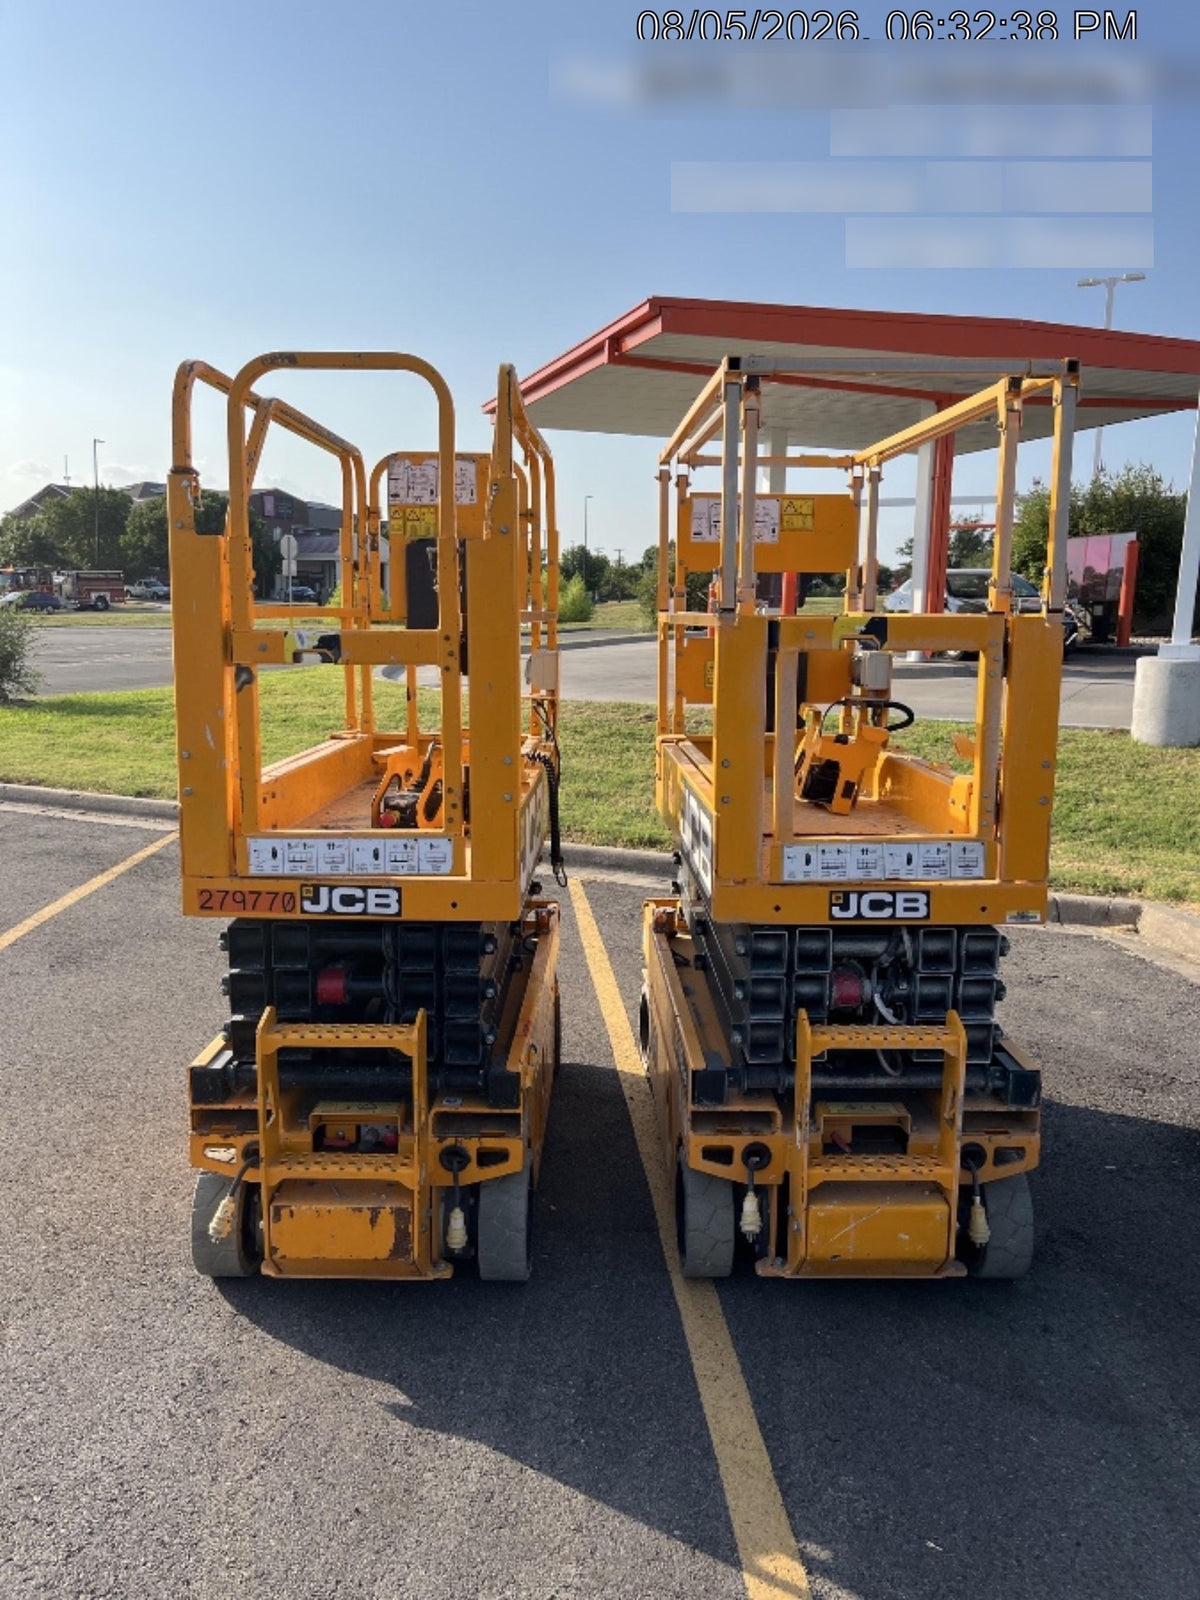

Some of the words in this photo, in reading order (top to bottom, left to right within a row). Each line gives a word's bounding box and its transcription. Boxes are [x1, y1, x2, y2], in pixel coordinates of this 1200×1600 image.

[199, 889, 296, 913] 279770
[302, 886, 400, 915] JCB
[831, 892, 928, 918] JCB
